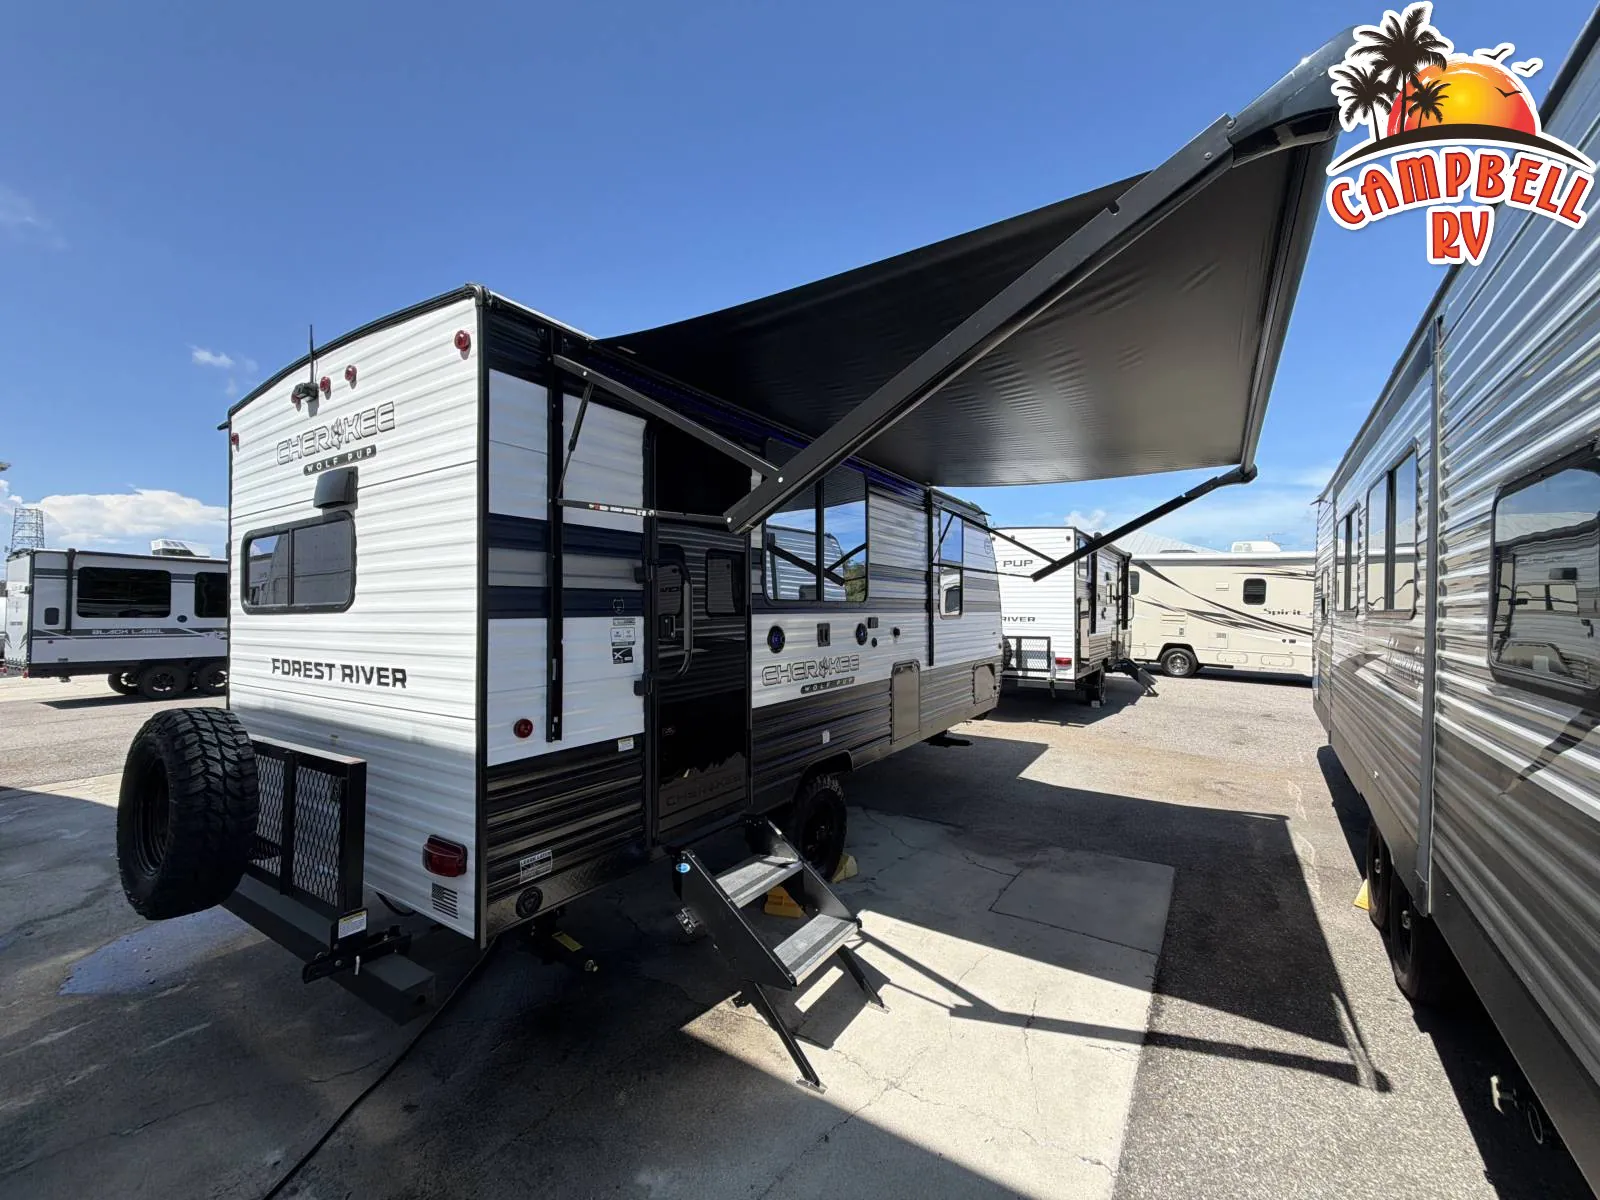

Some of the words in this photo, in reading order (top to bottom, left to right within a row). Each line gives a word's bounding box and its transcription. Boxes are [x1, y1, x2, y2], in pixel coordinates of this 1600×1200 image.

[276, 401, 396, 465] CHEROKEE
[307, 457, 339, 473] WOLF
[347, 447, 373, 462] PUP
[1003, 559, 1033, 567] PUP
[271, 657, 335, 683] FOREST
[340, 663, 407, 689] RIVER
[762, 655, 859, 686] CHEROKEE
[804, 682, 831, 693] WOLF
